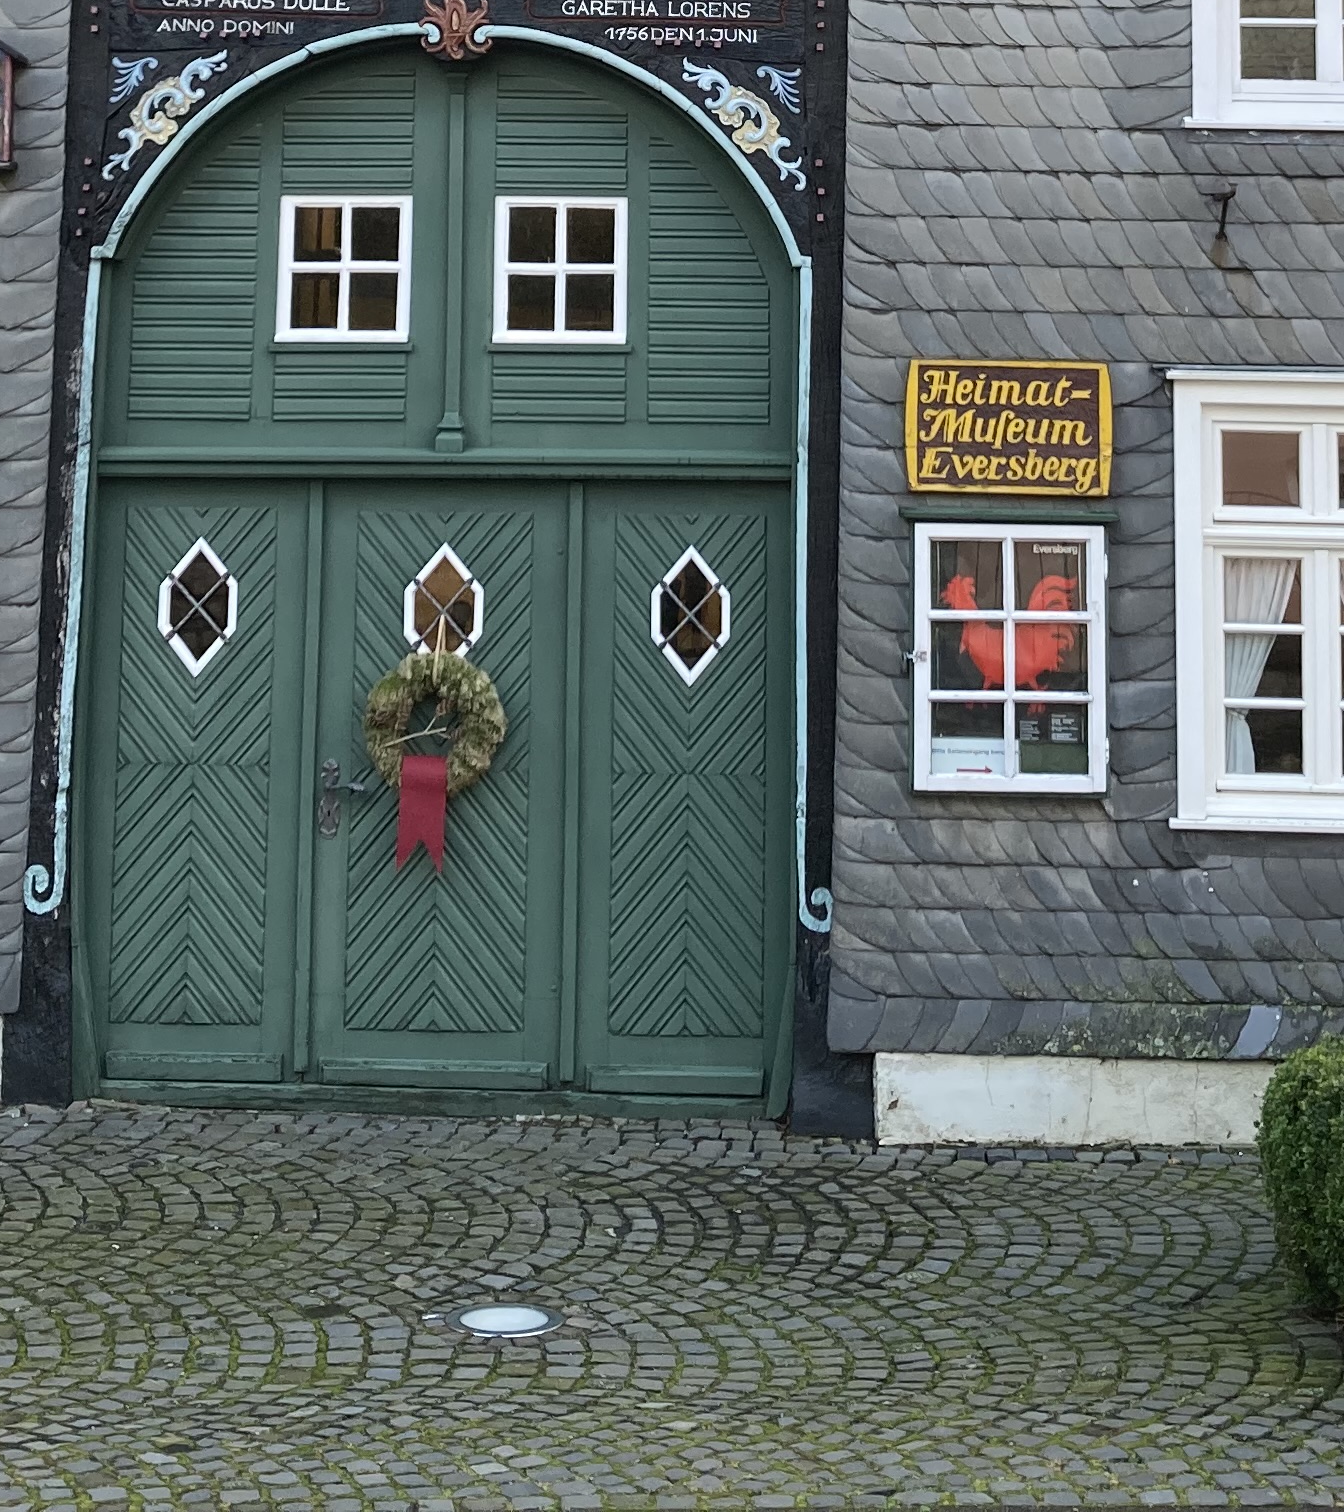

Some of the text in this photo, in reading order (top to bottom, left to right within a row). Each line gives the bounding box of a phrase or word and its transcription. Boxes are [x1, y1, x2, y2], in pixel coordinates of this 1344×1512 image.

[561, 0, 751, 19] GARETHA LORENS
[156, 18, 295, 35] ANNO DOMINI
[650, 27, 694, 42] DEN
[920, 369, 1092, 408] Heimat-
[919, 446, 1098, 494] Eversberg
